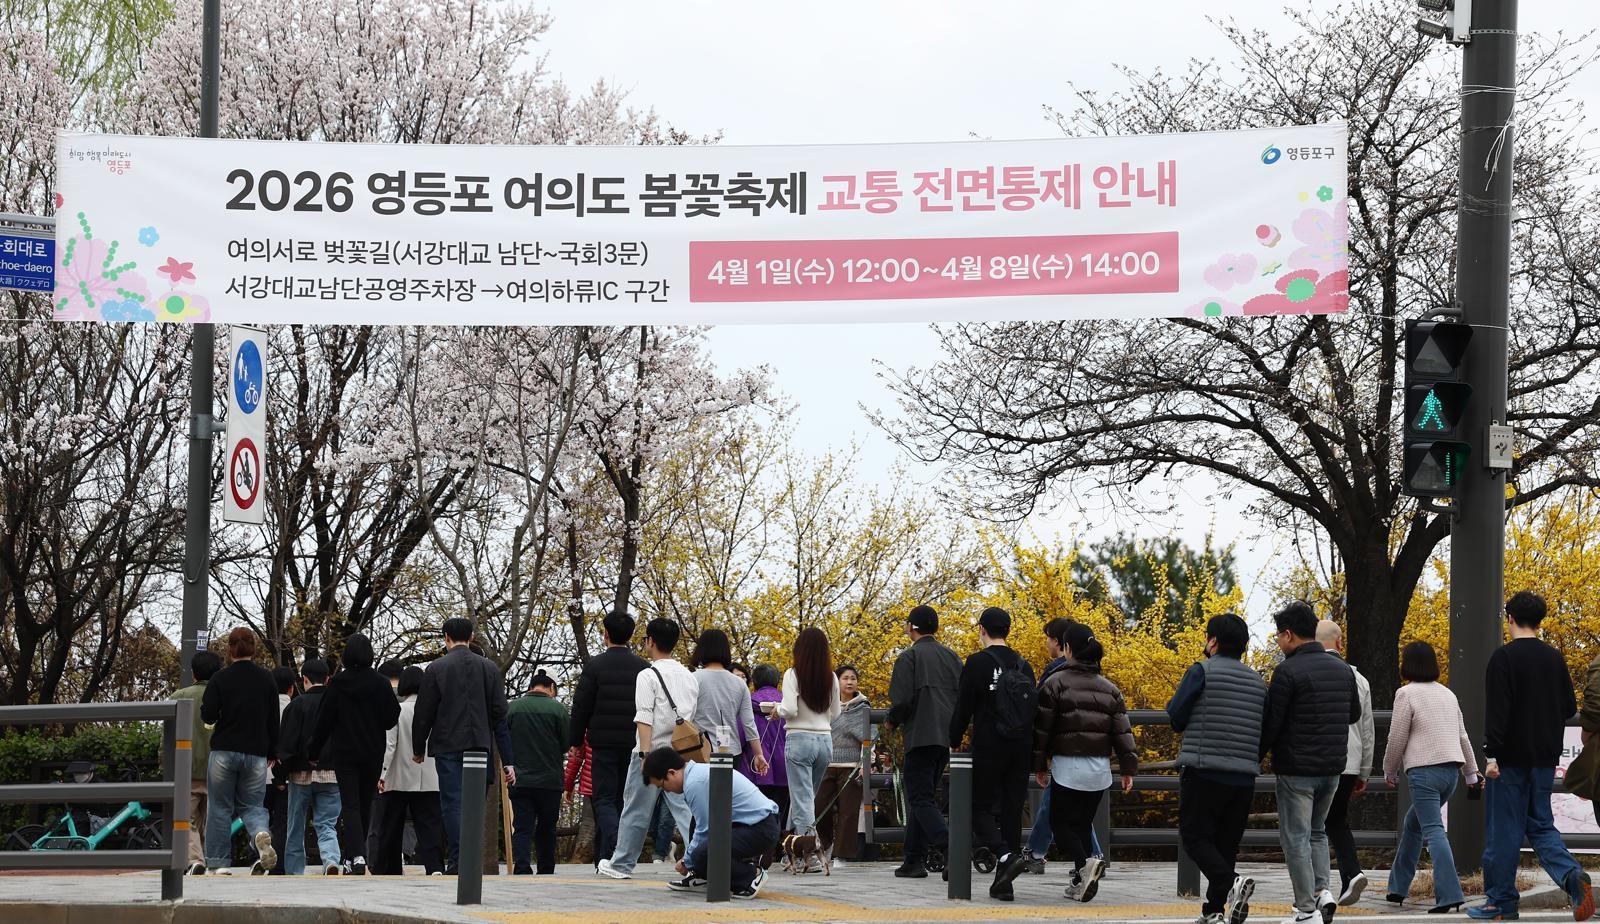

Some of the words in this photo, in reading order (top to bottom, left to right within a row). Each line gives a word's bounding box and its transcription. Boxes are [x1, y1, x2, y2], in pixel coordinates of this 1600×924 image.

[69, 145, 85, 161] 희망
[86, 145, 102, 163] 행복
[102, 144, 132, 159] 미래도시
[1286, 146, 1336, 161] 영등포구
[107, 159, 132, 176] 영등포
[225, 168, 355, 213] 2026
[366, 169, 494, 217] 영등포
[503, 172, 631, 218] 여의도
[638, 170, 808, 219] 봄꽃축제
[817, 170, 904, 215] 교통
[912, 163, 1081, 213] 전면통제
[1092, 159, 1177, 209] 안내
[0, 239, 48, 258] 회대로
[227, 237, 319, 264] 여의서로
[323, 239, 492, 267] 벚꽃길(서강대교
[497, 240, 649, 267] 남단~국회3문)
[707, 258, 749, 285] 4월
[755, 257, 835, 285] 1일(수)
[989, 253, 1073, 280] 8일(수)
[1080, 250, 1160, 278] 14:00
[224, 274, 477, 303] 서강대교남단공영주차장
[506, 278, 619, 304] 여의하류IC
[624, 278, 671, 304] 구간
